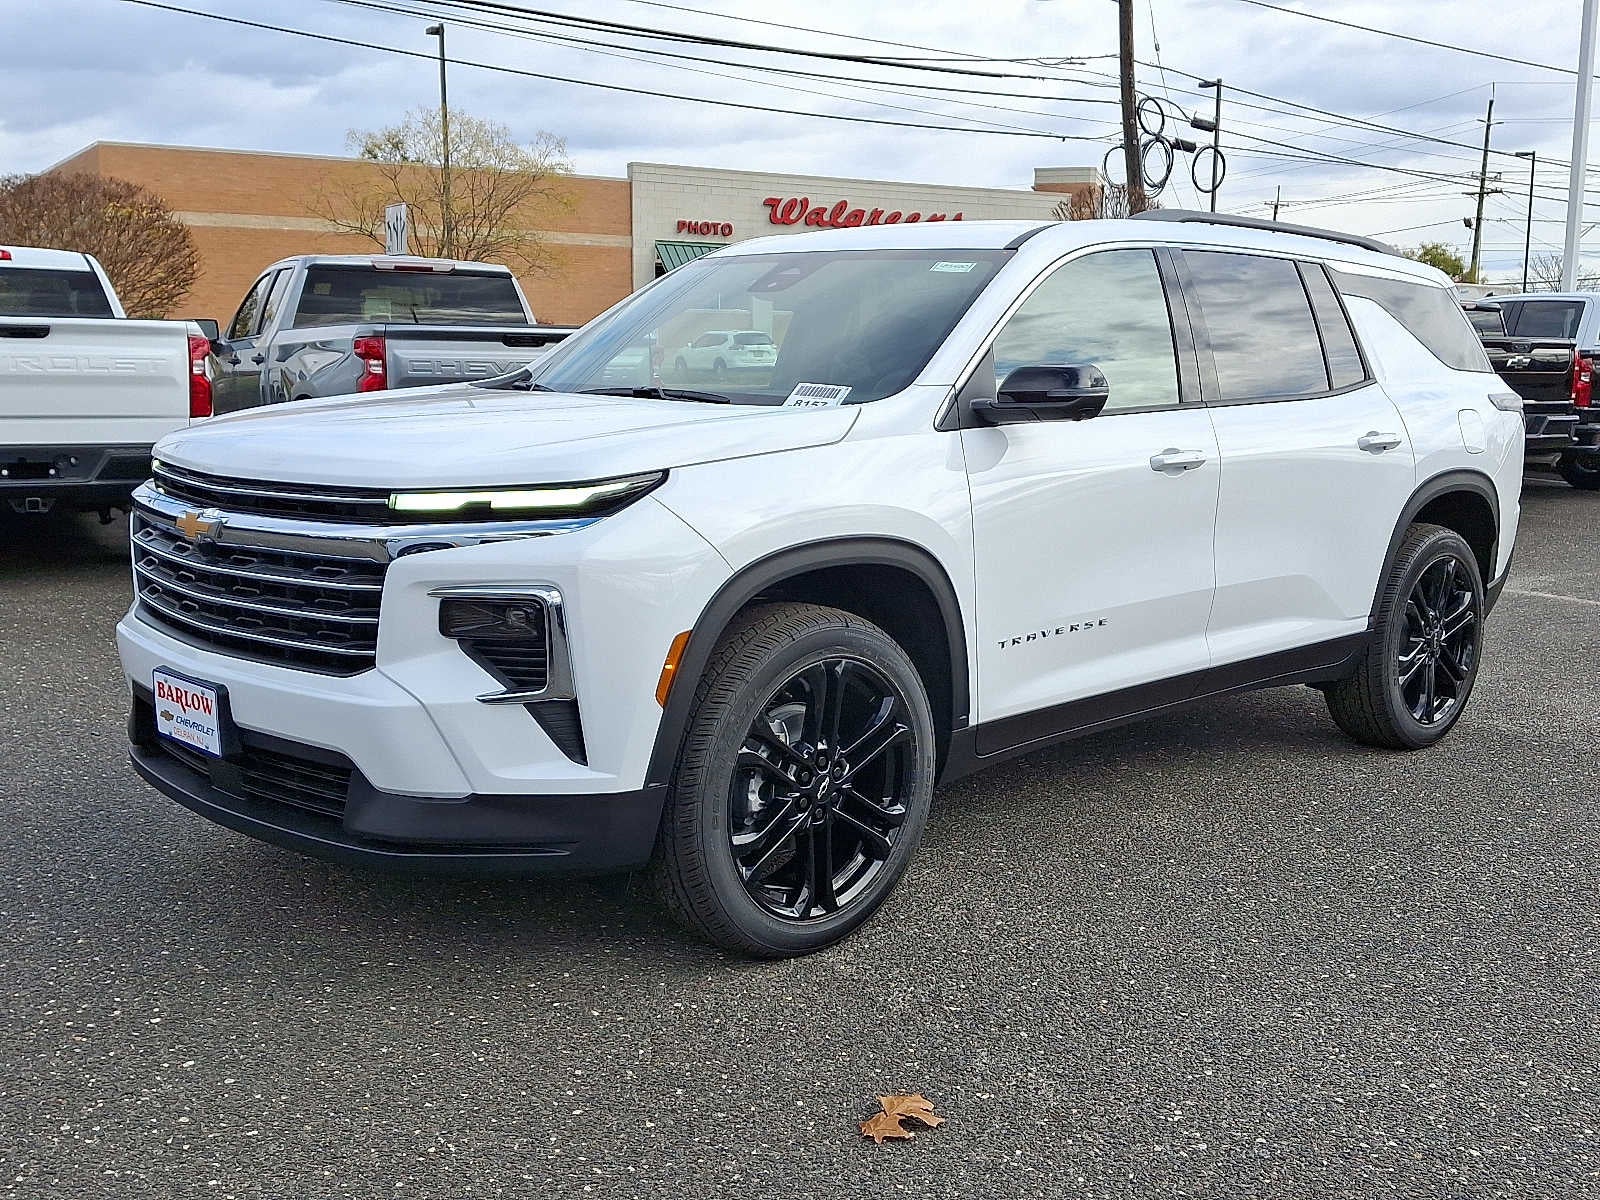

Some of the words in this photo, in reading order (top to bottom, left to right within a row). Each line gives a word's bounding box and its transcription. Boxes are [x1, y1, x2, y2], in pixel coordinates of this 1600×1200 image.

[676, 220, 733, 237] PHOTO
[1, 356, 168, 373] ROLET
[998, 618, 1108, 649] TRAVERSE
[156, 681, 214, 716] BARLOW
[175, 715, 216, 737] CHEVROLET
